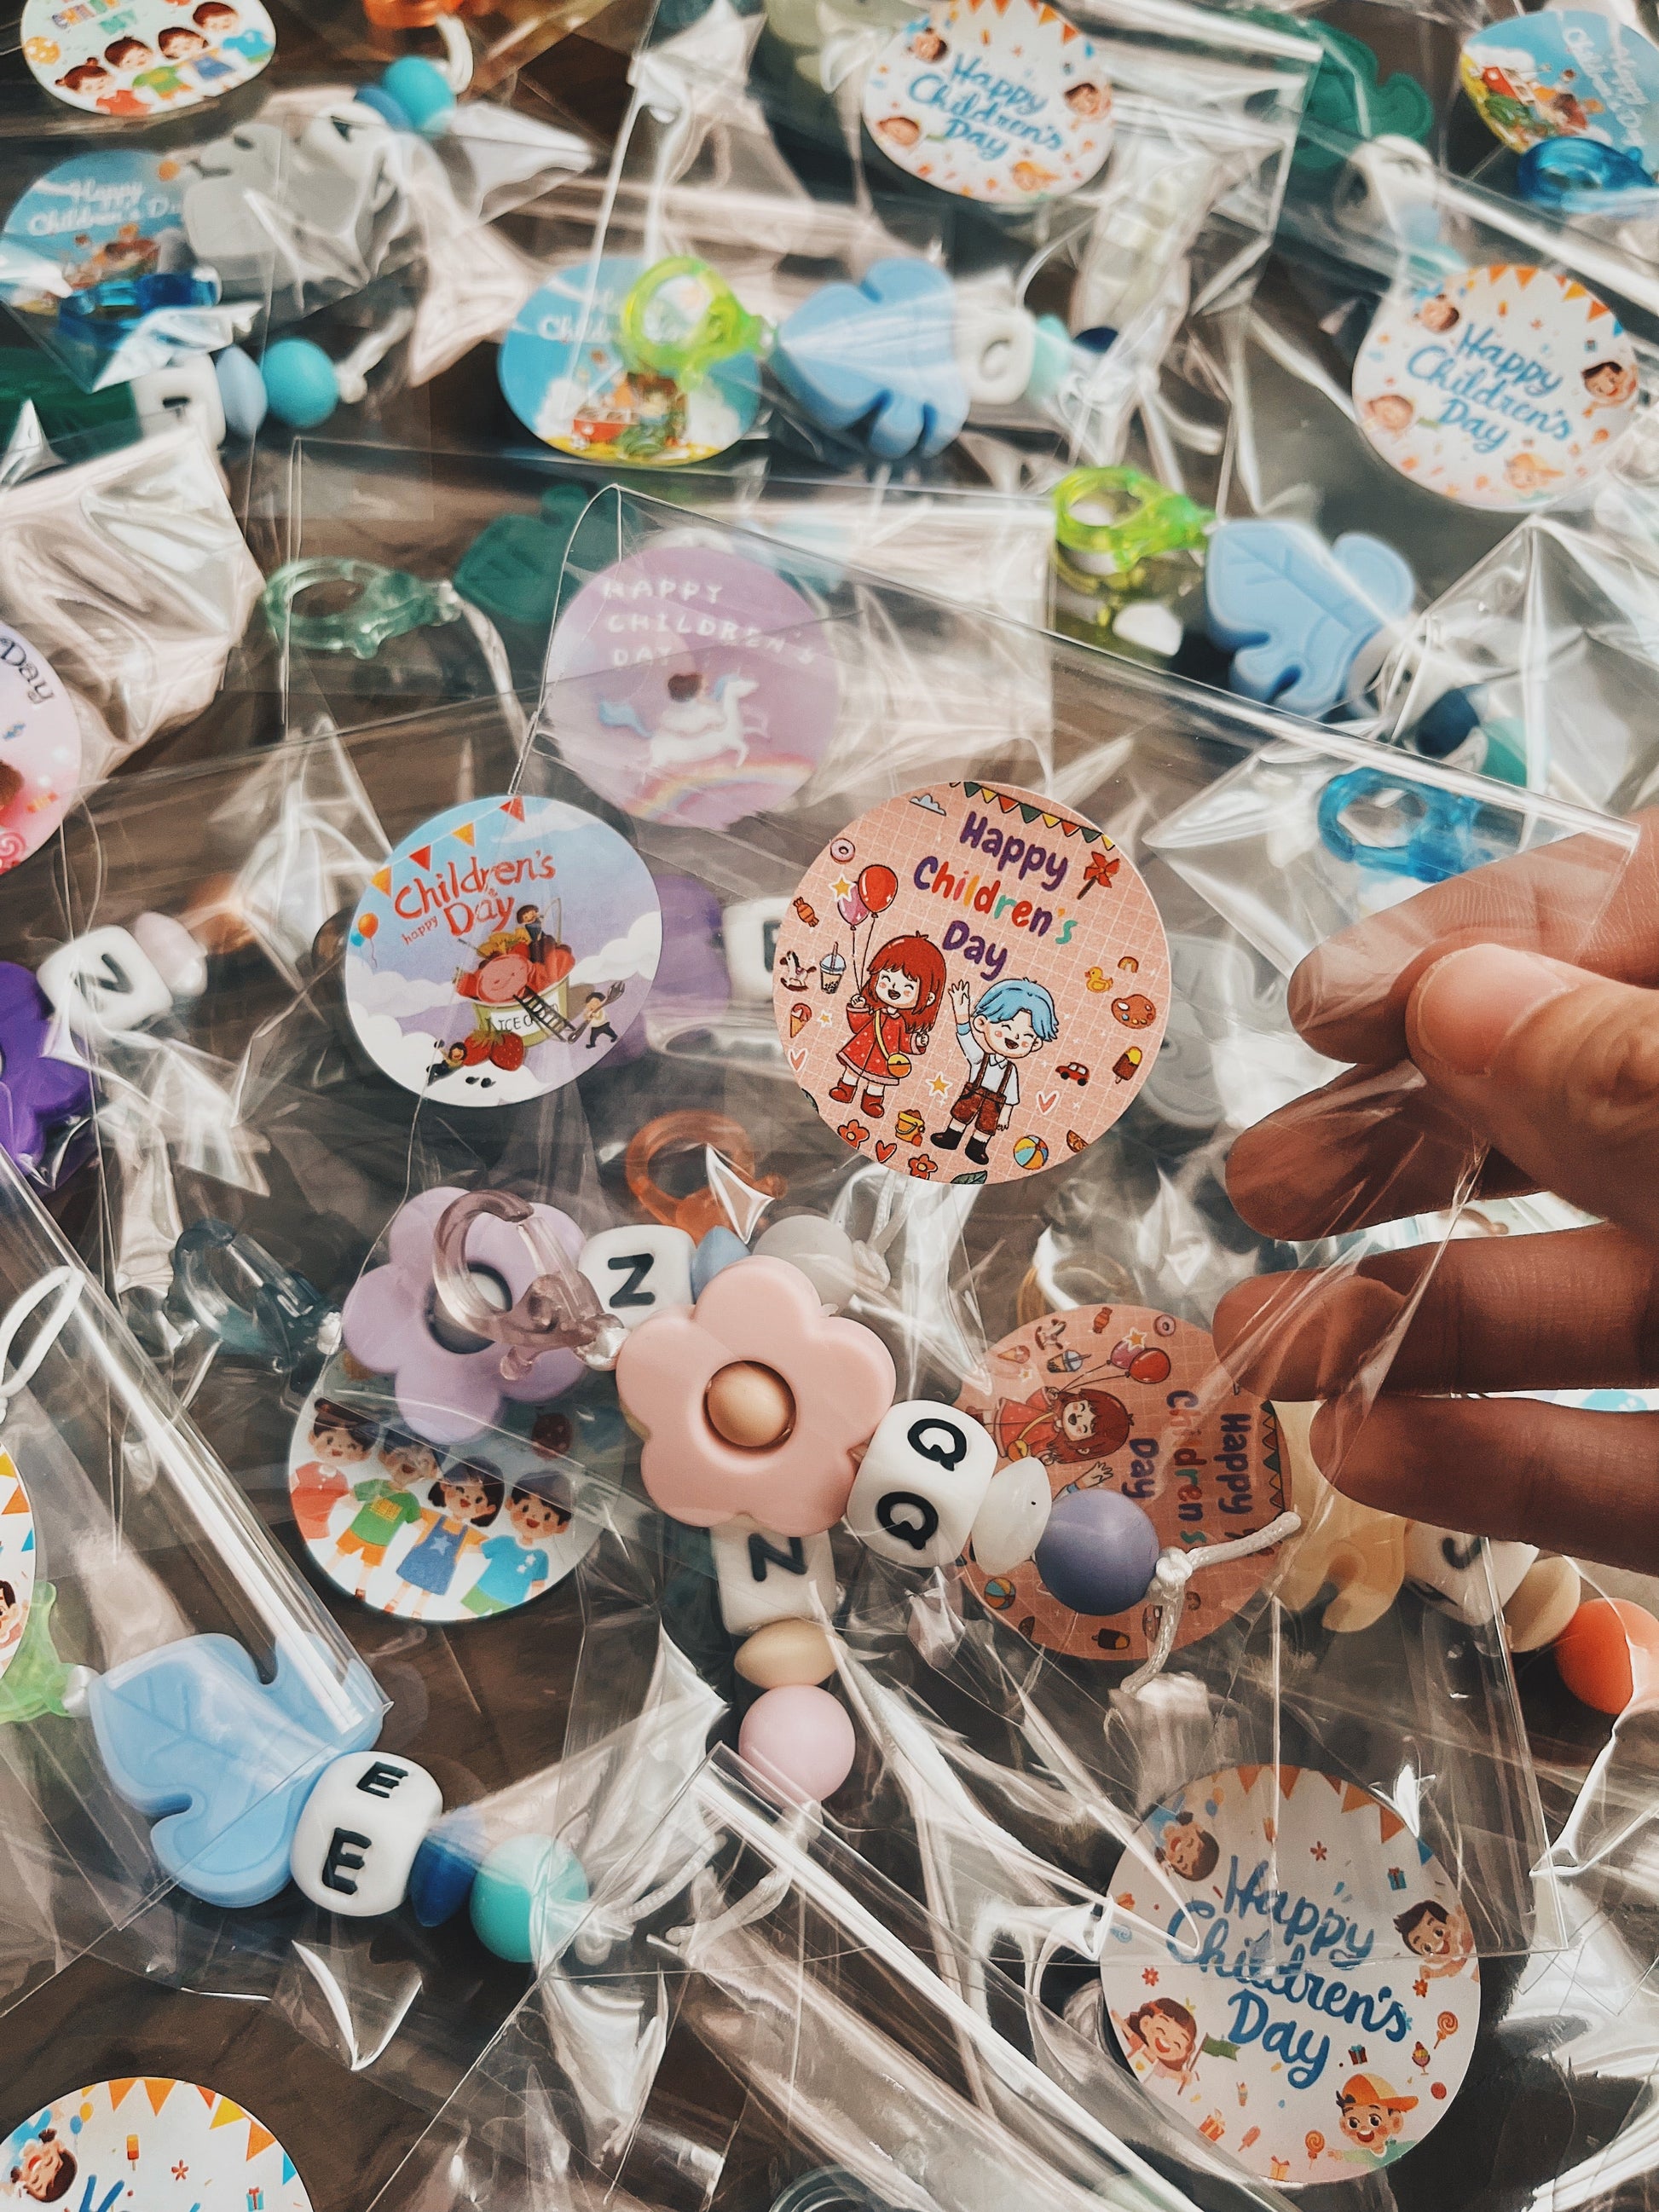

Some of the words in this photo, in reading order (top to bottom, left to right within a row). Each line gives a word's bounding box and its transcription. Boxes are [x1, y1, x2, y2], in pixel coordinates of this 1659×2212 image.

[909, 73, 1062, 150] Children's
[951, 53, 1048, 115] Happy
[945, 117, 1009, 160] Day
[1455, 323, 1564, 398] Happy
[1407, 345, 1573, 441] Children's
[1437, 397, 1510, 453] Day
[603, 580, 723, 604] HAPPY
[0, 636, 55, 705] Day
[613, 645, 673, 667] DAY
[959, 811, 1069, 892] Happy
[395, 850, 556, 920] Children's
[913, 855, 1078, 944] Children's
[401, 915, 438, 945] happy
[443, 896, 515, 937] Day
[941, 920, 1009, 981] Day
[907, 1418, 968, 1471] Q
[1121, 1437, 1160, 1499] Day
[1213, 1412, 1253, 1515] Happy
[877, 1491, 939, 1551] Q
[356, 1761, 409, 1799] E
[321, 1827, 373, 1896] E
[1224, 1855, 1373, 1971] Happy
[1228, 1989, 1330, 2089] Day
